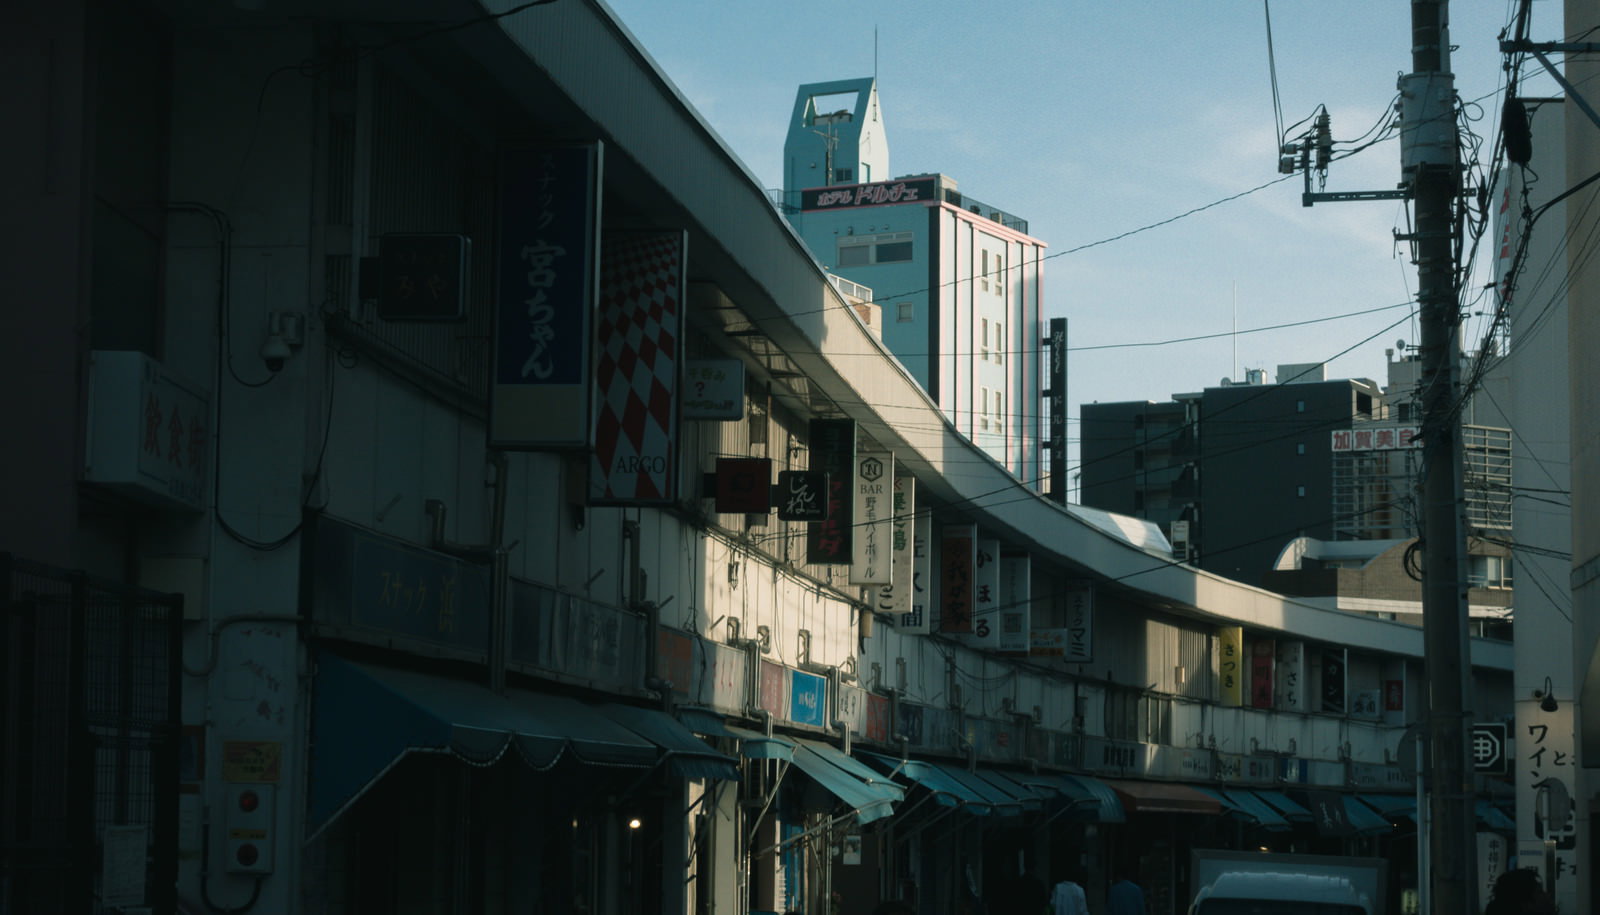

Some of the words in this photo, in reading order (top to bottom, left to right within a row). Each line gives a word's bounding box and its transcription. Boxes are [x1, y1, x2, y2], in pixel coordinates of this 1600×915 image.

[817, 189, 853, 207] ホテル
[855, 182, 919, 205] ドルチェ
[521, 239, 567, 380] 宮ちゃん
[1333, 427, 1424, 449] 加賀美自
[615, 456, 667, 474] ARGO
[860, 484, 883, 495] BAR
[1528, 724, 1550, 789] ワイン
